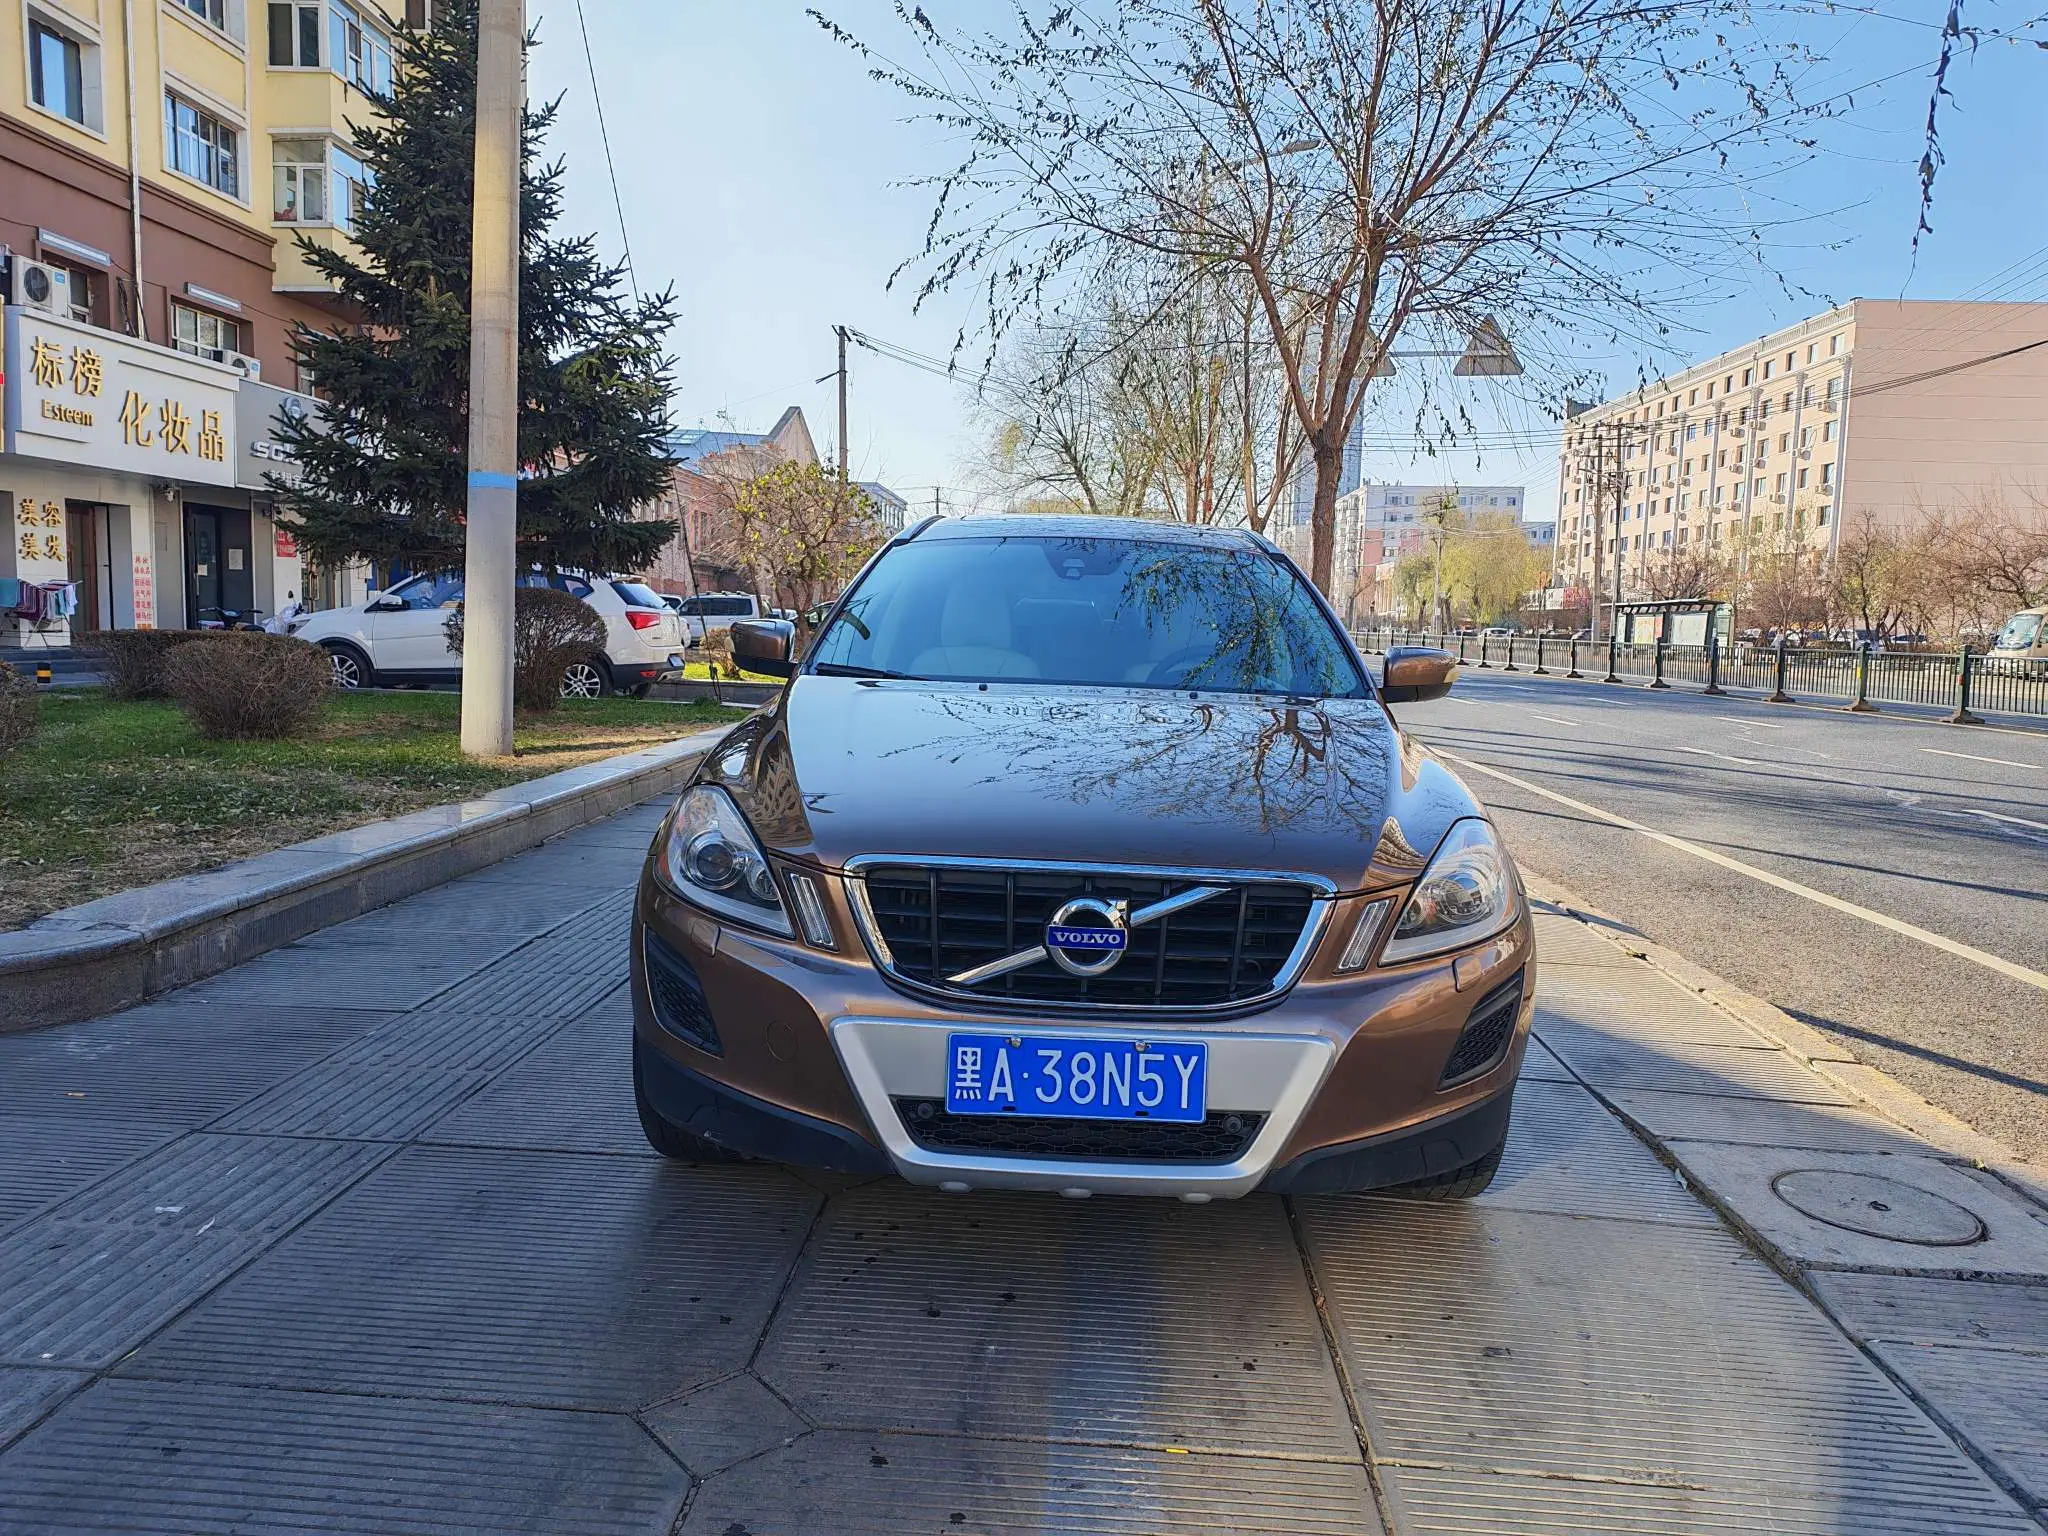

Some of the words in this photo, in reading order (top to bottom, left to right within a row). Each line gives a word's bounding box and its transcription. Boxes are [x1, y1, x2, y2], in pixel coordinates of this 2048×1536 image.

[29, 335, 104, 397] 标榜
[42, 399, 94, 427] Esteem
[119, 390, 225, 462] 化妆品
[17, 498, 63, 528] 美容
[18, 532, 65, 562] 美发
[1053, 931, 1121, 945] VOLVO
